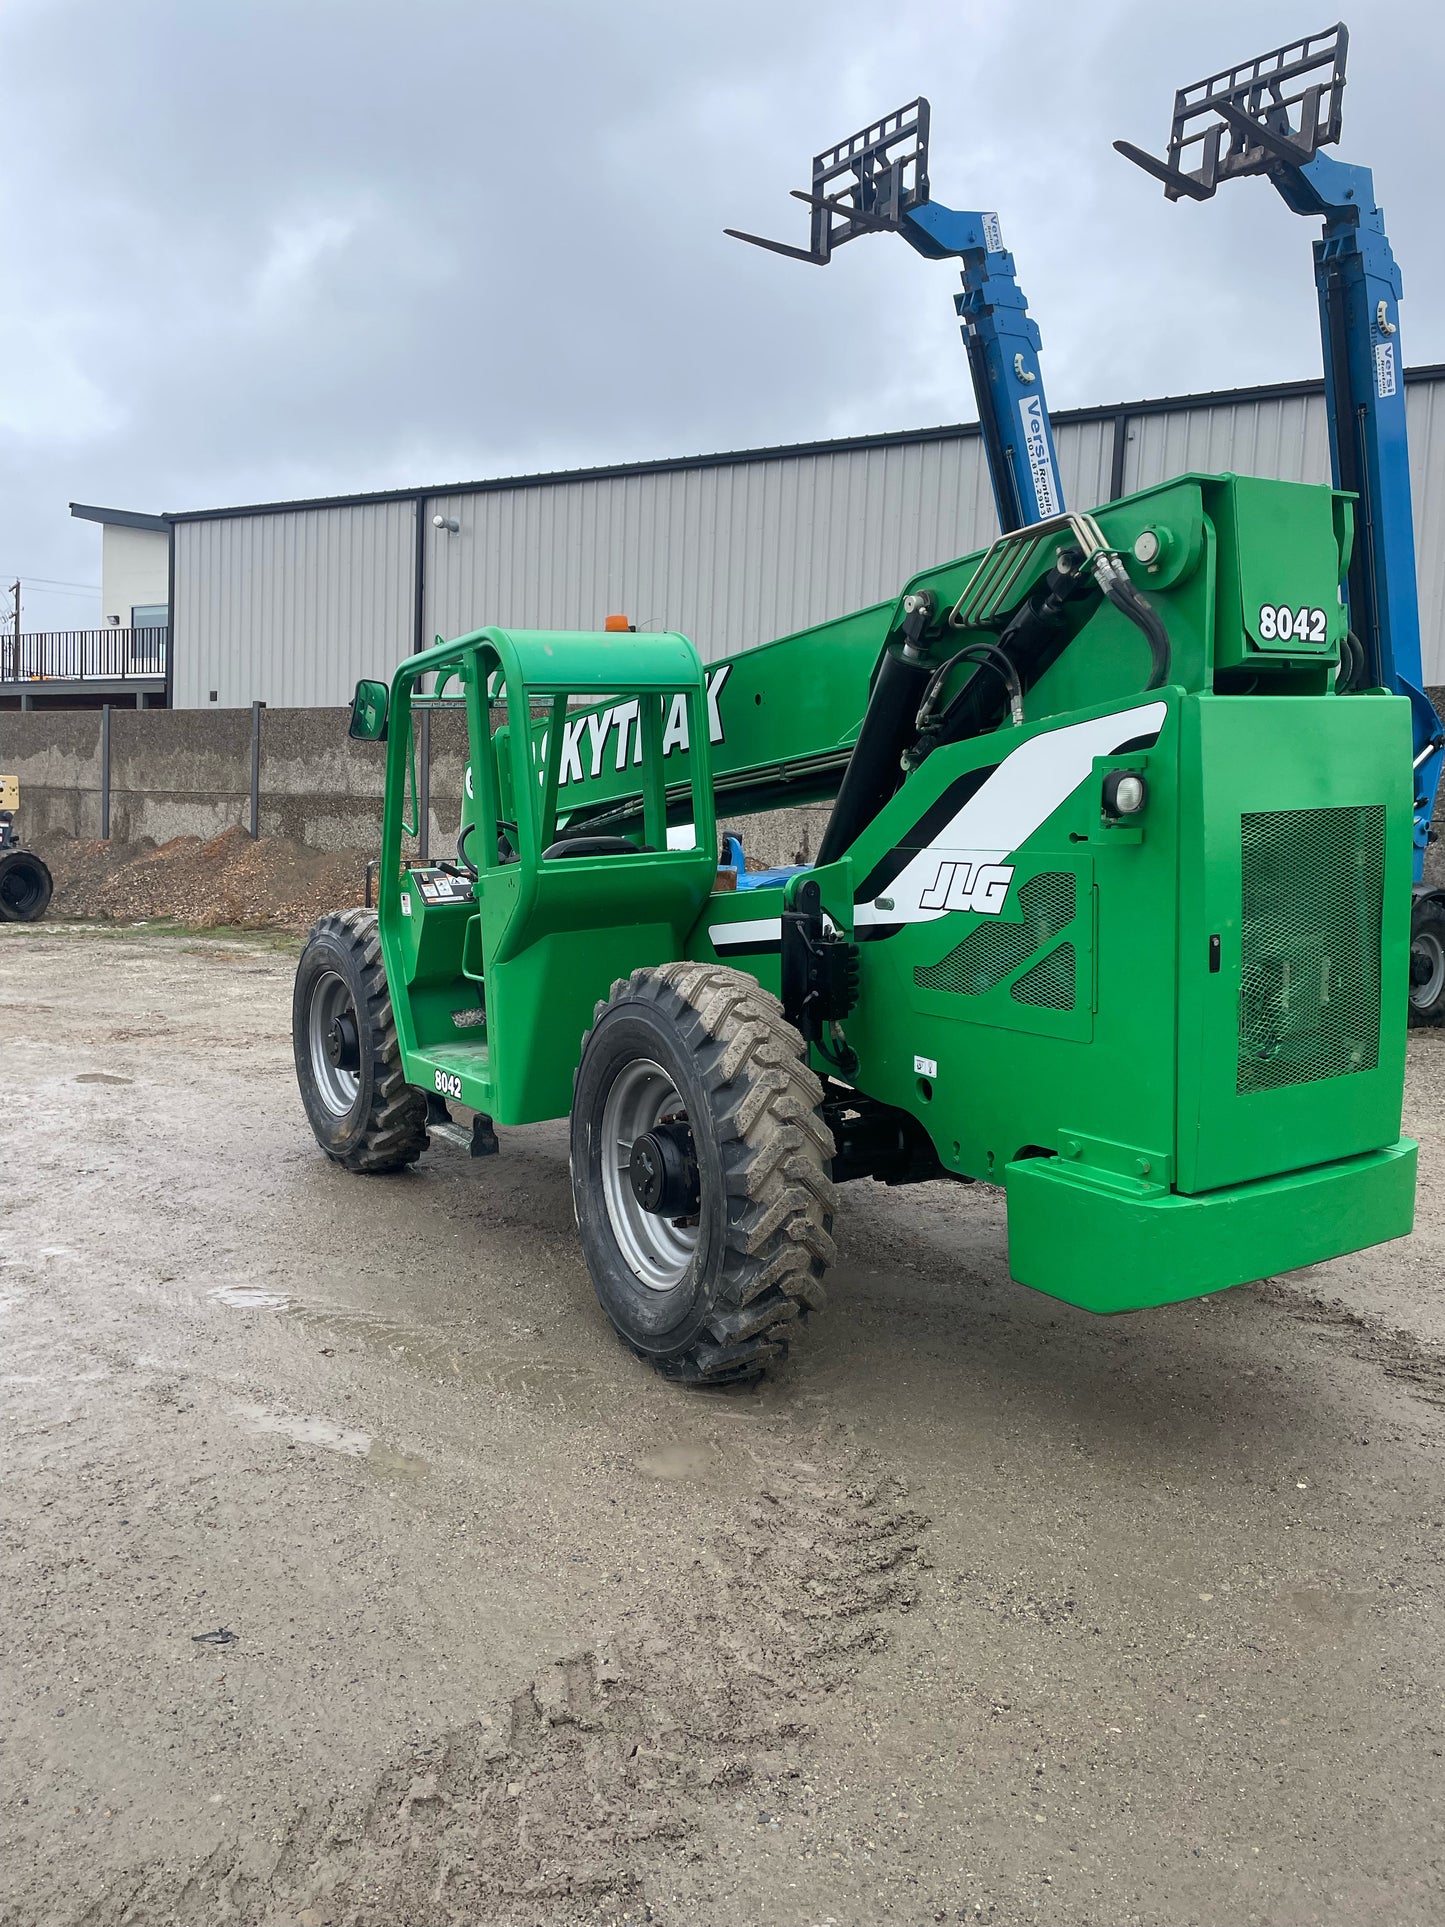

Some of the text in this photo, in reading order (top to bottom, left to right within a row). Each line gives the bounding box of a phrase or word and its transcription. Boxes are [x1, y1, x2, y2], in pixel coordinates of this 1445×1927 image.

[991, 215, 1002, 250] Versi
[1385, 345, 1395, 393] Versi
[1028, 399, 1053, 514] Versi Rentals
[1259, 603, 1328, 644] 8042
[538, 664, 733, 788] KYTAK
[919, 862, 1016, 915] JLG
[434, 1069, 463, 1100] 8042
